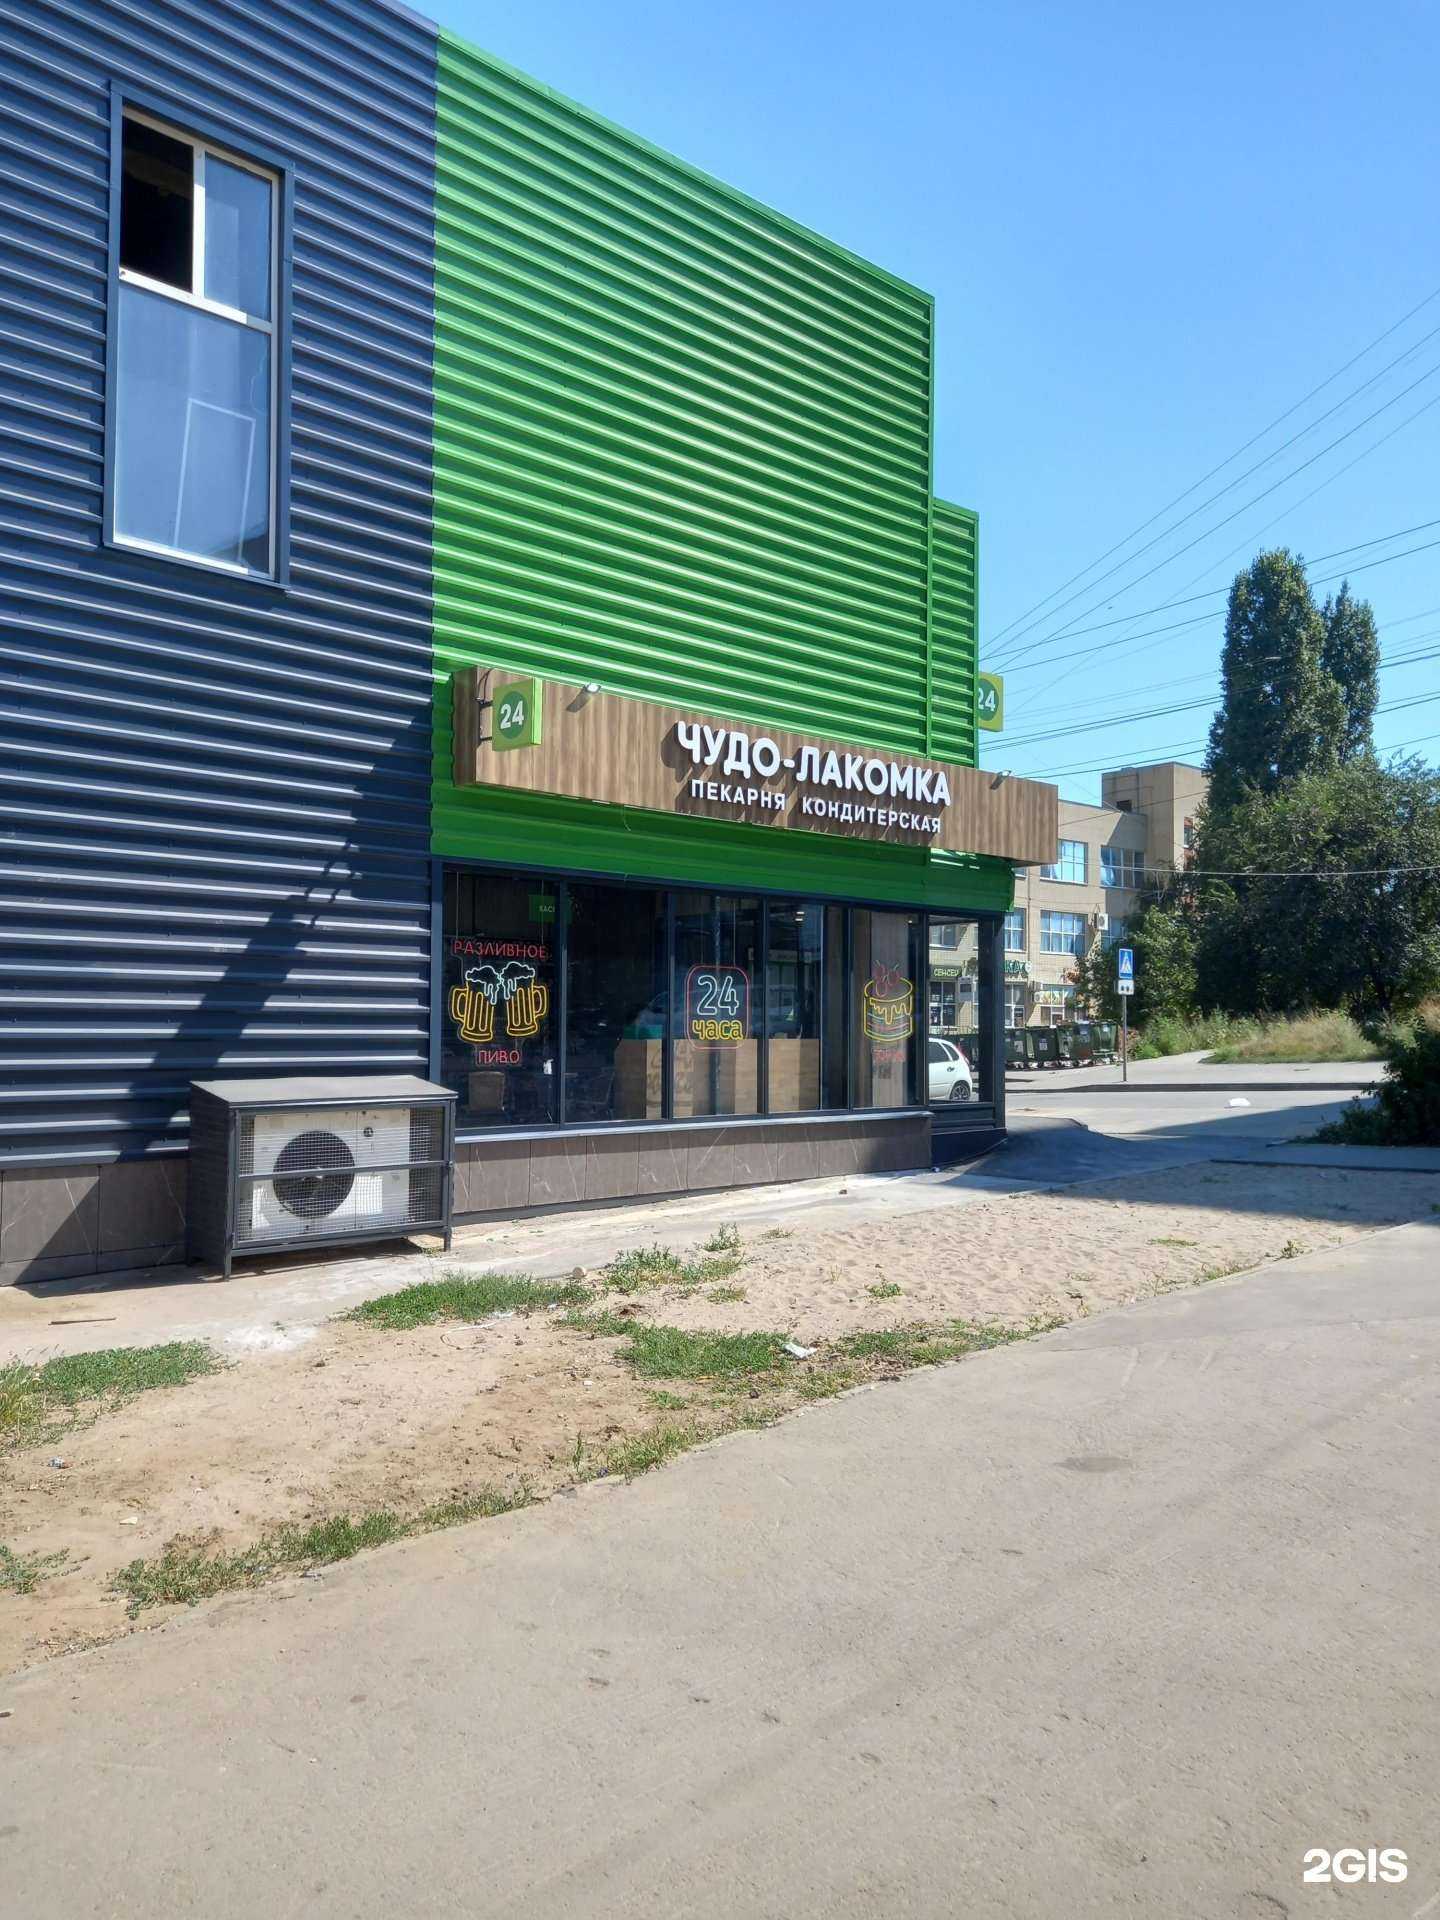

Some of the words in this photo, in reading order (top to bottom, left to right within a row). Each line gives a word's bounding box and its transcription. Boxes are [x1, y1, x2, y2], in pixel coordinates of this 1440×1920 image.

[978, 687, 996, 712] 24
[500, 700, 524, 729] 24
[678, 721, 951, 805] ЧУДО-ЛАКОМКА
[691, 779, 786, 811] ПЕКАРНЯ
[802, 797, 942, 834] КОНДИТЕРСКАЯ
[453, 940, 547, 960] РАЗЛИВНОЕ
[697, 975, 740, 1016] 24
[692, 1019, 743, 1040] часа
[477, 1050, 521, 1065] ПИВО
